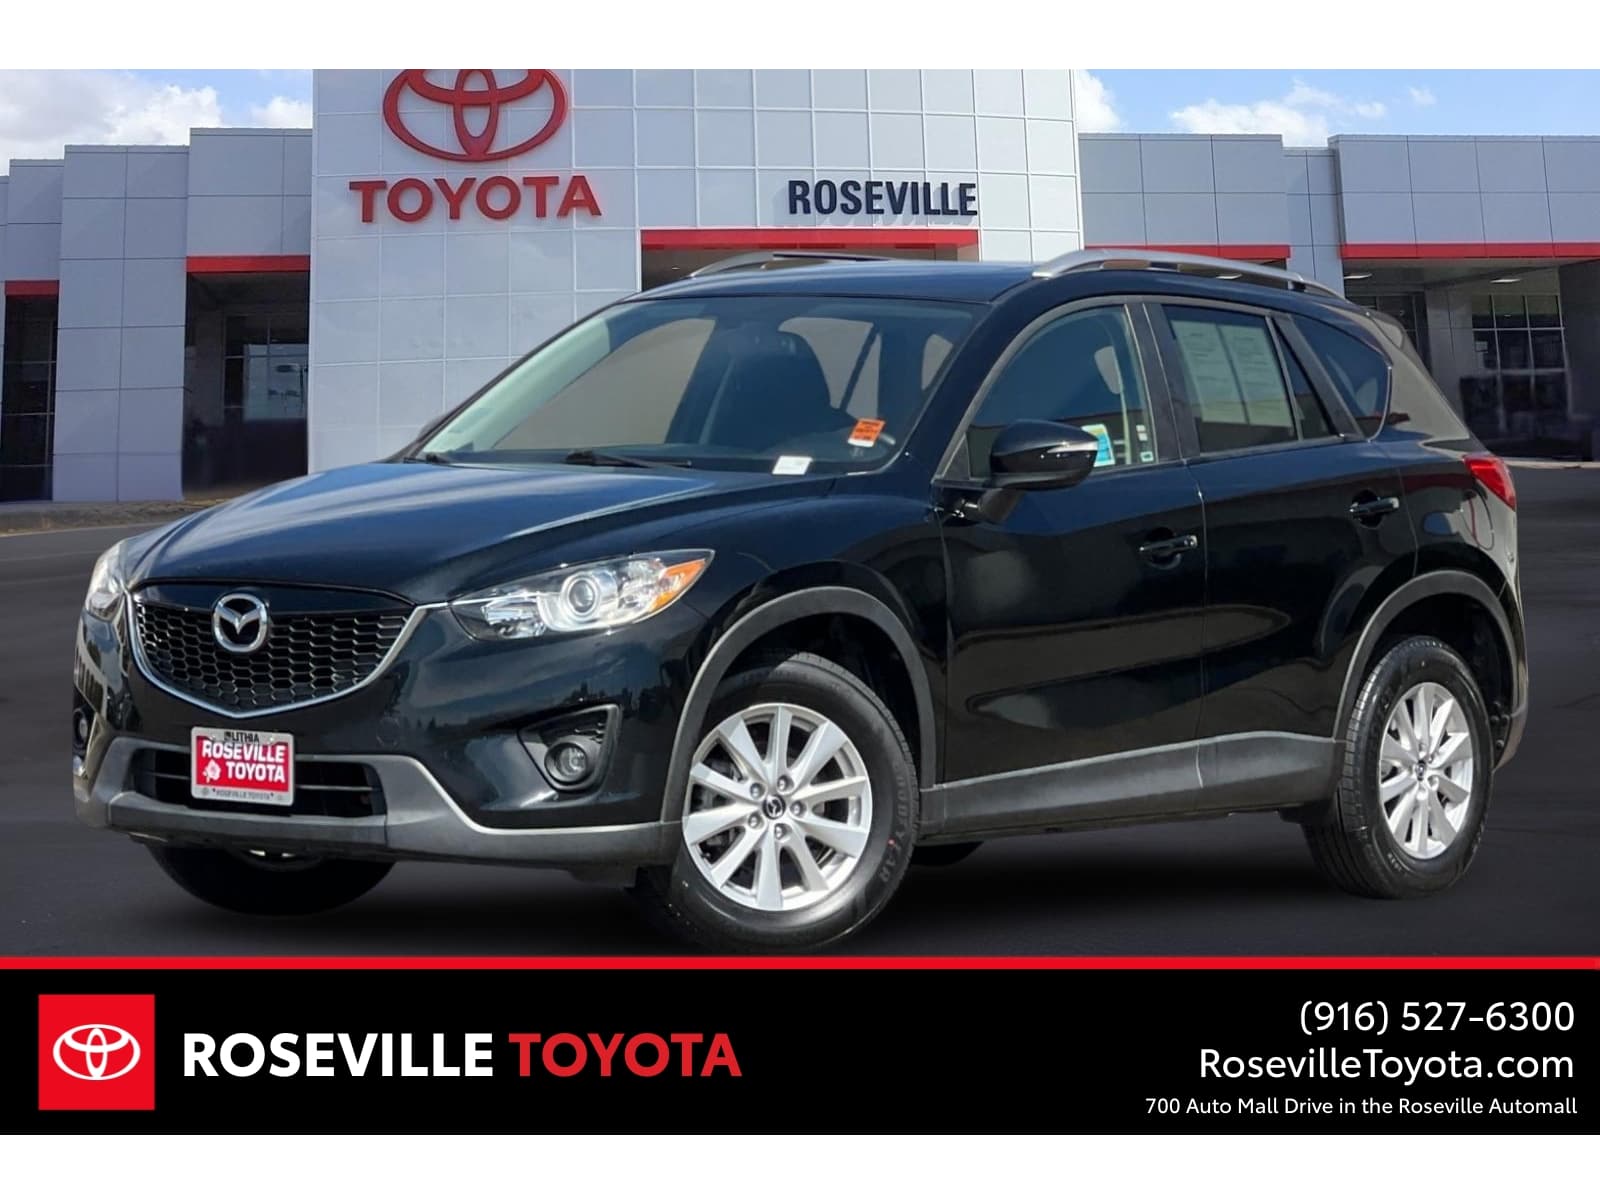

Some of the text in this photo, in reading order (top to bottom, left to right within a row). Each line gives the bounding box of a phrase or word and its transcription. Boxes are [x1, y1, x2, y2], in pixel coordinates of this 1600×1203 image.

[349, 175, 602, 224] TOYOTA
[788, 179, 979, 217] ROSEVILLE
[231, 732, 260, 743] LITHIA
[202, 740, 286, 763] ROSEVILLE
[226, 761, 286, 783] TOYOTA
